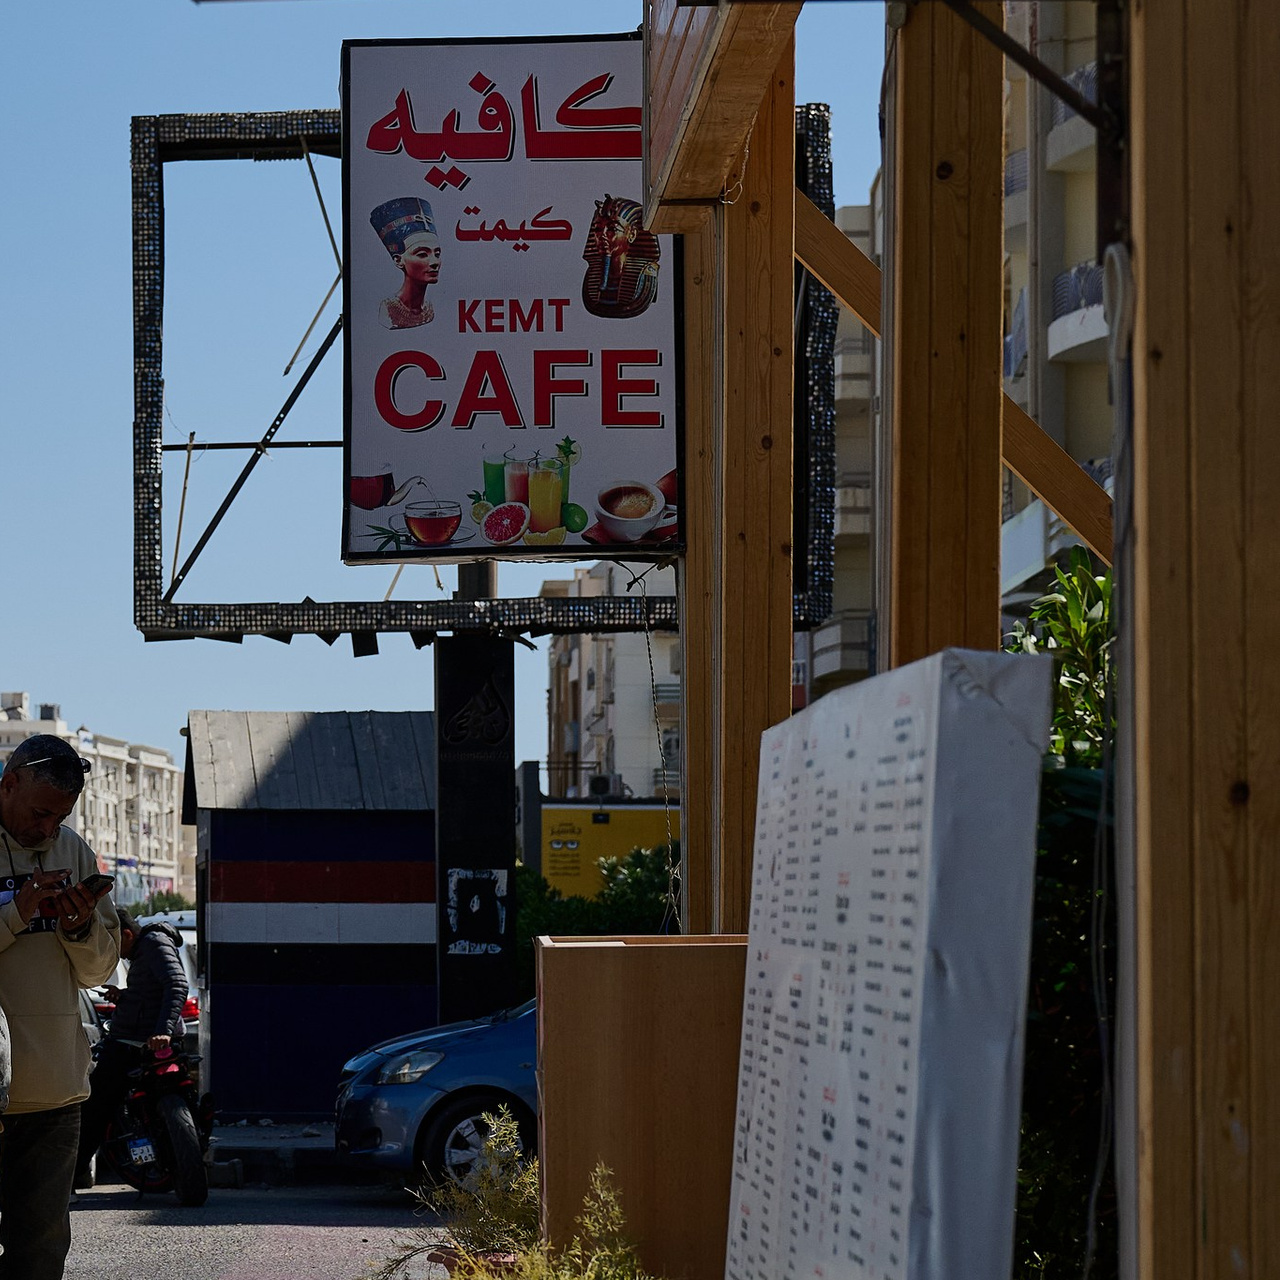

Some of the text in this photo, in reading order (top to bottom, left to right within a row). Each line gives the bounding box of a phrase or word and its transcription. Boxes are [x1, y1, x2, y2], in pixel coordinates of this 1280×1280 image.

[454, 205, 573, 253] كيمت
[457, 298, 571, 334] KEMT
[373, 348, 665, 433] CAFE
